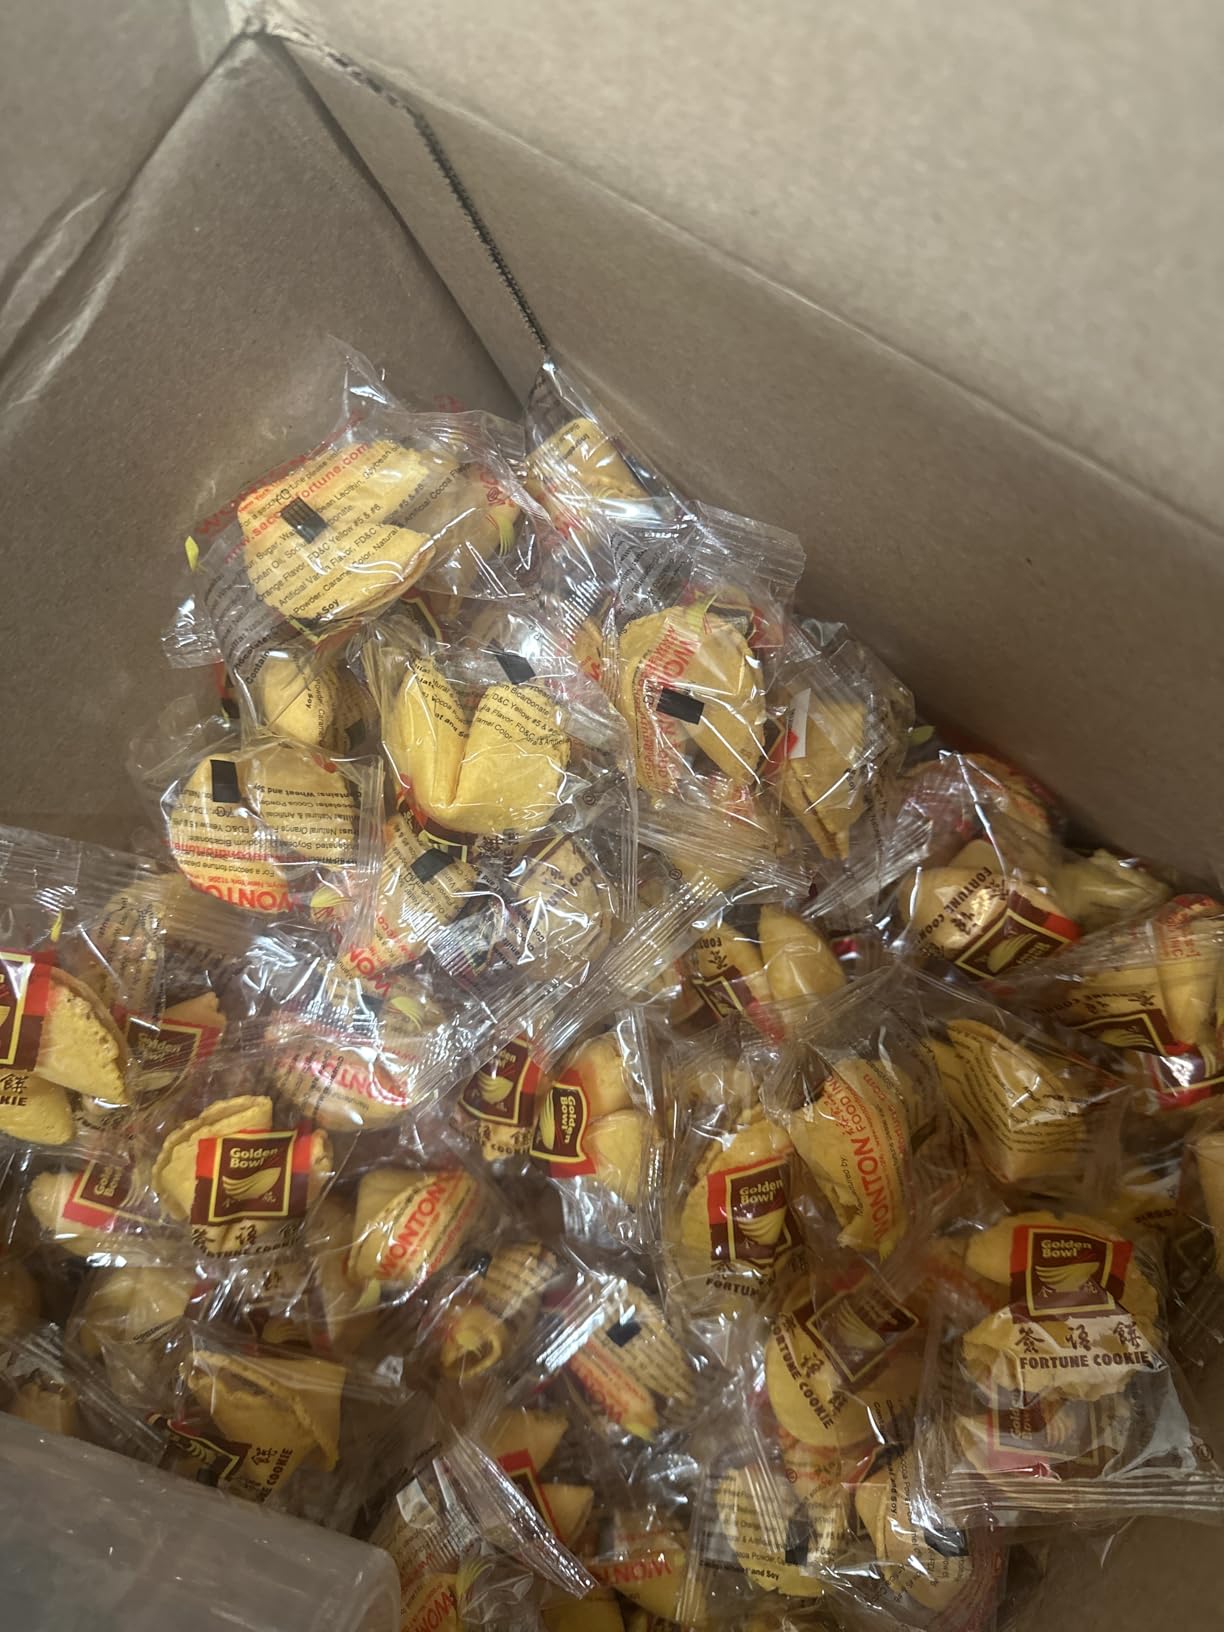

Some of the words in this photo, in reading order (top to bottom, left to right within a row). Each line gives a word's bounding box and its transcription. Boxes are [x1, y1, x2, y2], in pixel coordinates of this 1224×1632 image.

[254, 577, 285, 603] Orange
[306, 541, 331, 563] FD&C
[328, 523, 354, 546] Yellow
[351, 515, 364, 527] #5
[361, 510, 370, 520] &
[255, 537, 282, 561] Sugar,
[292, 588, 325, 616] Powder,
[371, 526, 400, 552] Natural
[426, 475, 455, 501] Cocoa
[277, 580, 308, 607] Artificial
[352, 525, 378, 548] FD&C
[320, 596, 341, 616] Soy
[309, 827, 336, 835] Natural
[228, 864, 253, 873] second
[190, 879, 303, 914] WONTO
[939, 864, 994, 915] FORTUNE
[559, 1095, 571, 1137] Bowl
[564, 1094, 579, 1145] Golden
[838, 1095, 865, 1135] FOOD
[229, 1147, 279, 1161] Golden
[229, 1157, 266, 1170] Bowl
[739, 1178, 784, 1196] Golden
[740, 1190, 775, 1205] Bowl
[840, 1133, 900, 1243] WONTON
[377, 1183, 447, 1278] WONTON
[1040, 1238, 1093, 1251] Golden
[1041, 1247, 1078, 1259] Bowl
[704, 1277, 759, 1298] FORTUN
[760, 1320, 809, 1380] ORTUNE
[796, 1379, 835, 1429] COOKIE
[1020, 1354, 1090, 1370] FORTUNE
[1092, 1350, 1150, 1367] COOKIE
[264, 1445, 293, 1487] COOKIE
